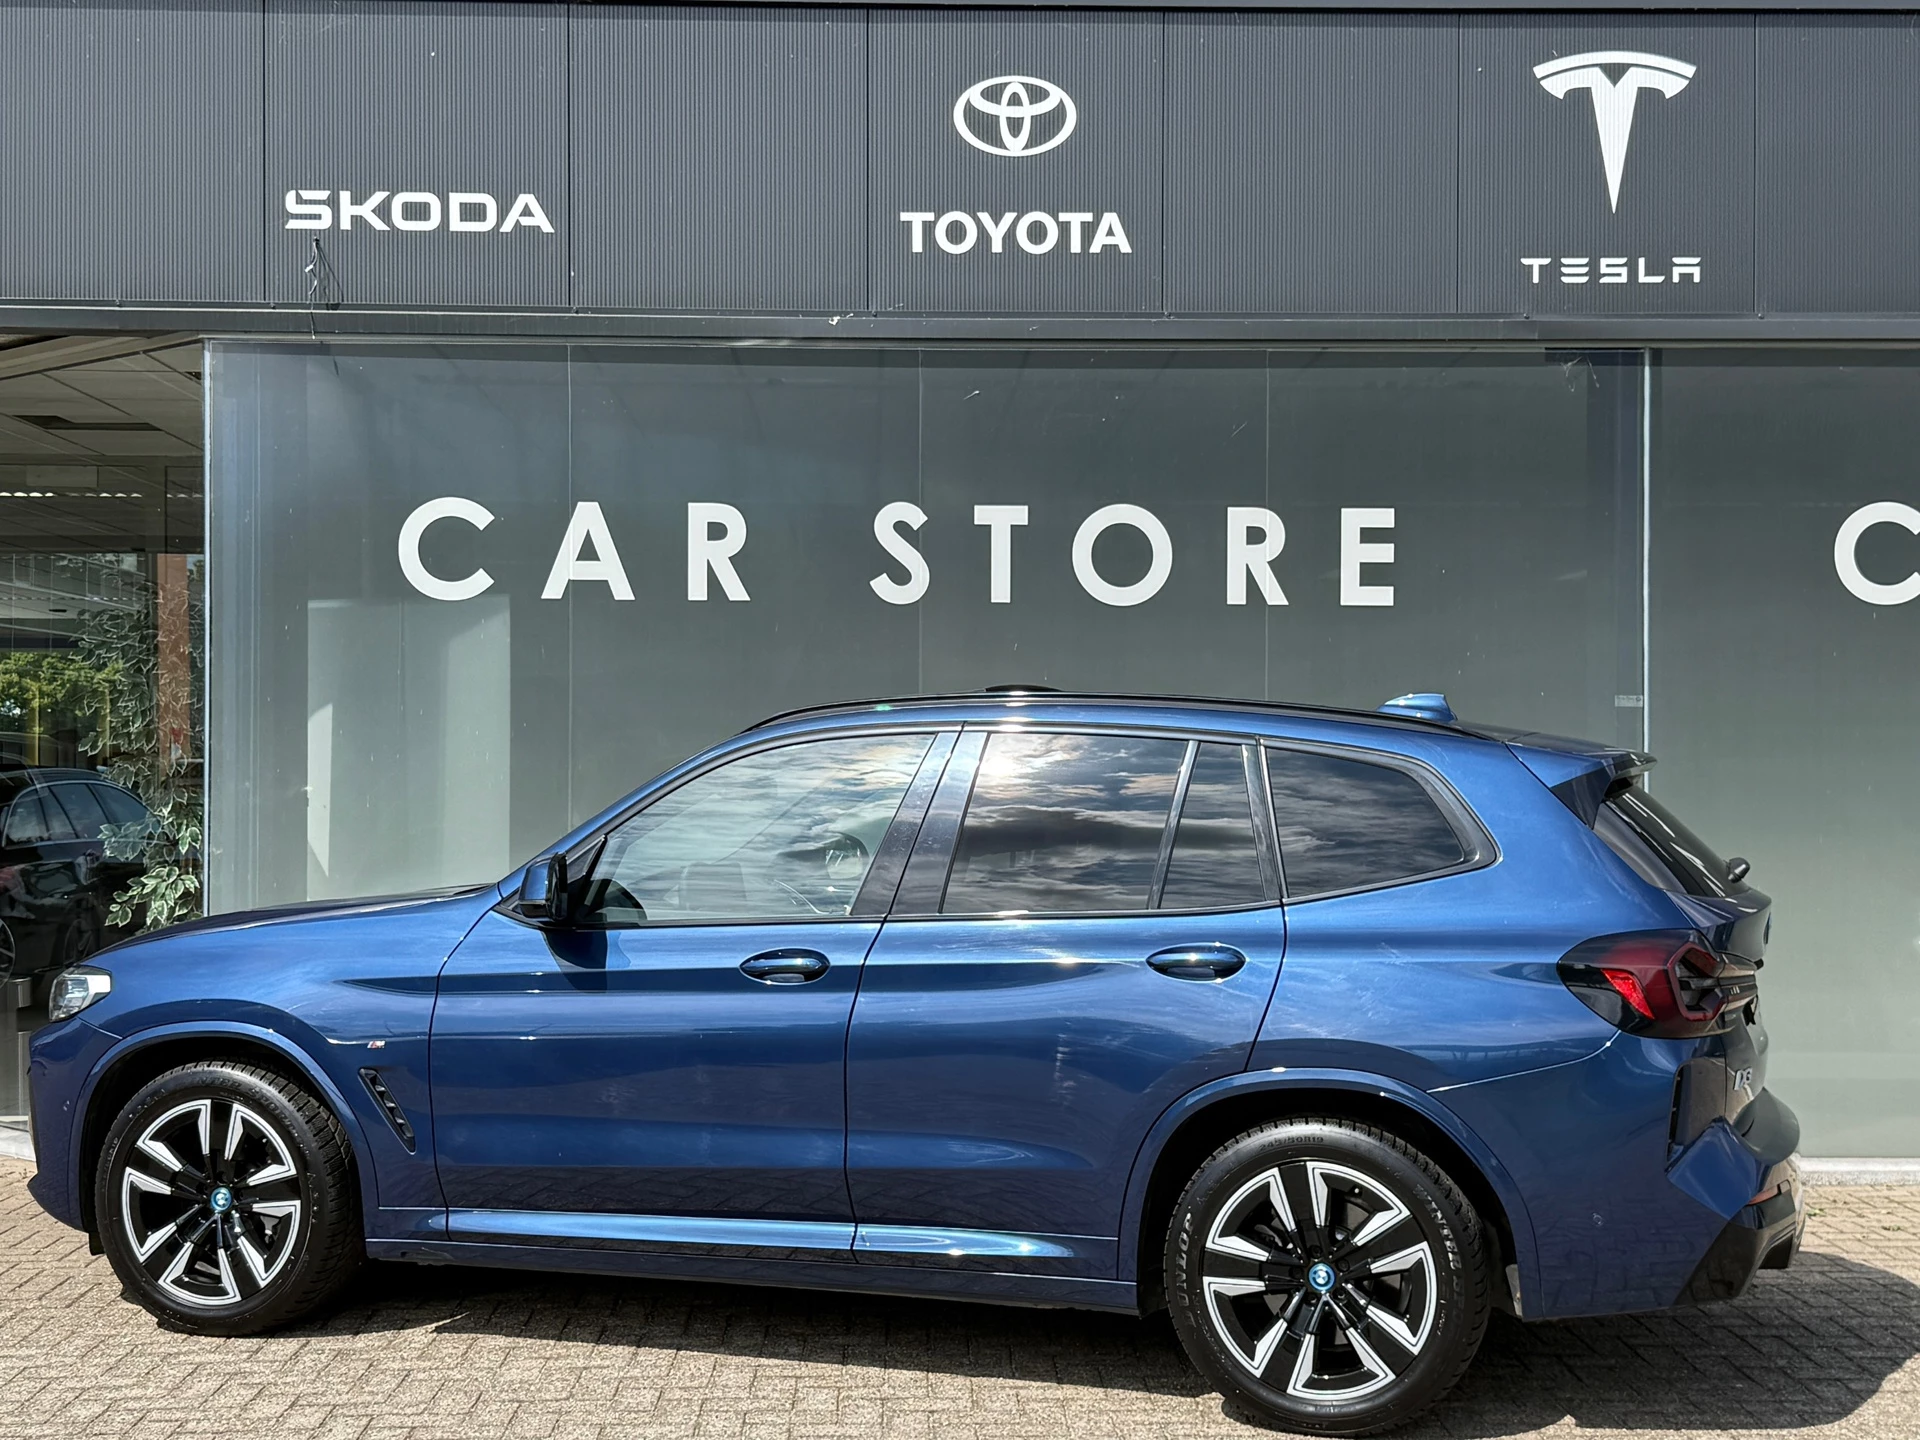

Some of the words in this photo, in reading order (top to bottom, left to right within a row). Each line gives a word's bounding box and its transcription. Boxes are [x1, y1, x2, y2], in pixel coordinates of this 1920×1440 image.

[285, 190, 555, 233] SKODA
[900, 211, 1132, 254] TOYOTA
[1521, 257, 1701, 283] TESLA
[399, 497, 750, 601] CAR
[870, 502, 1395, 606] STORE
